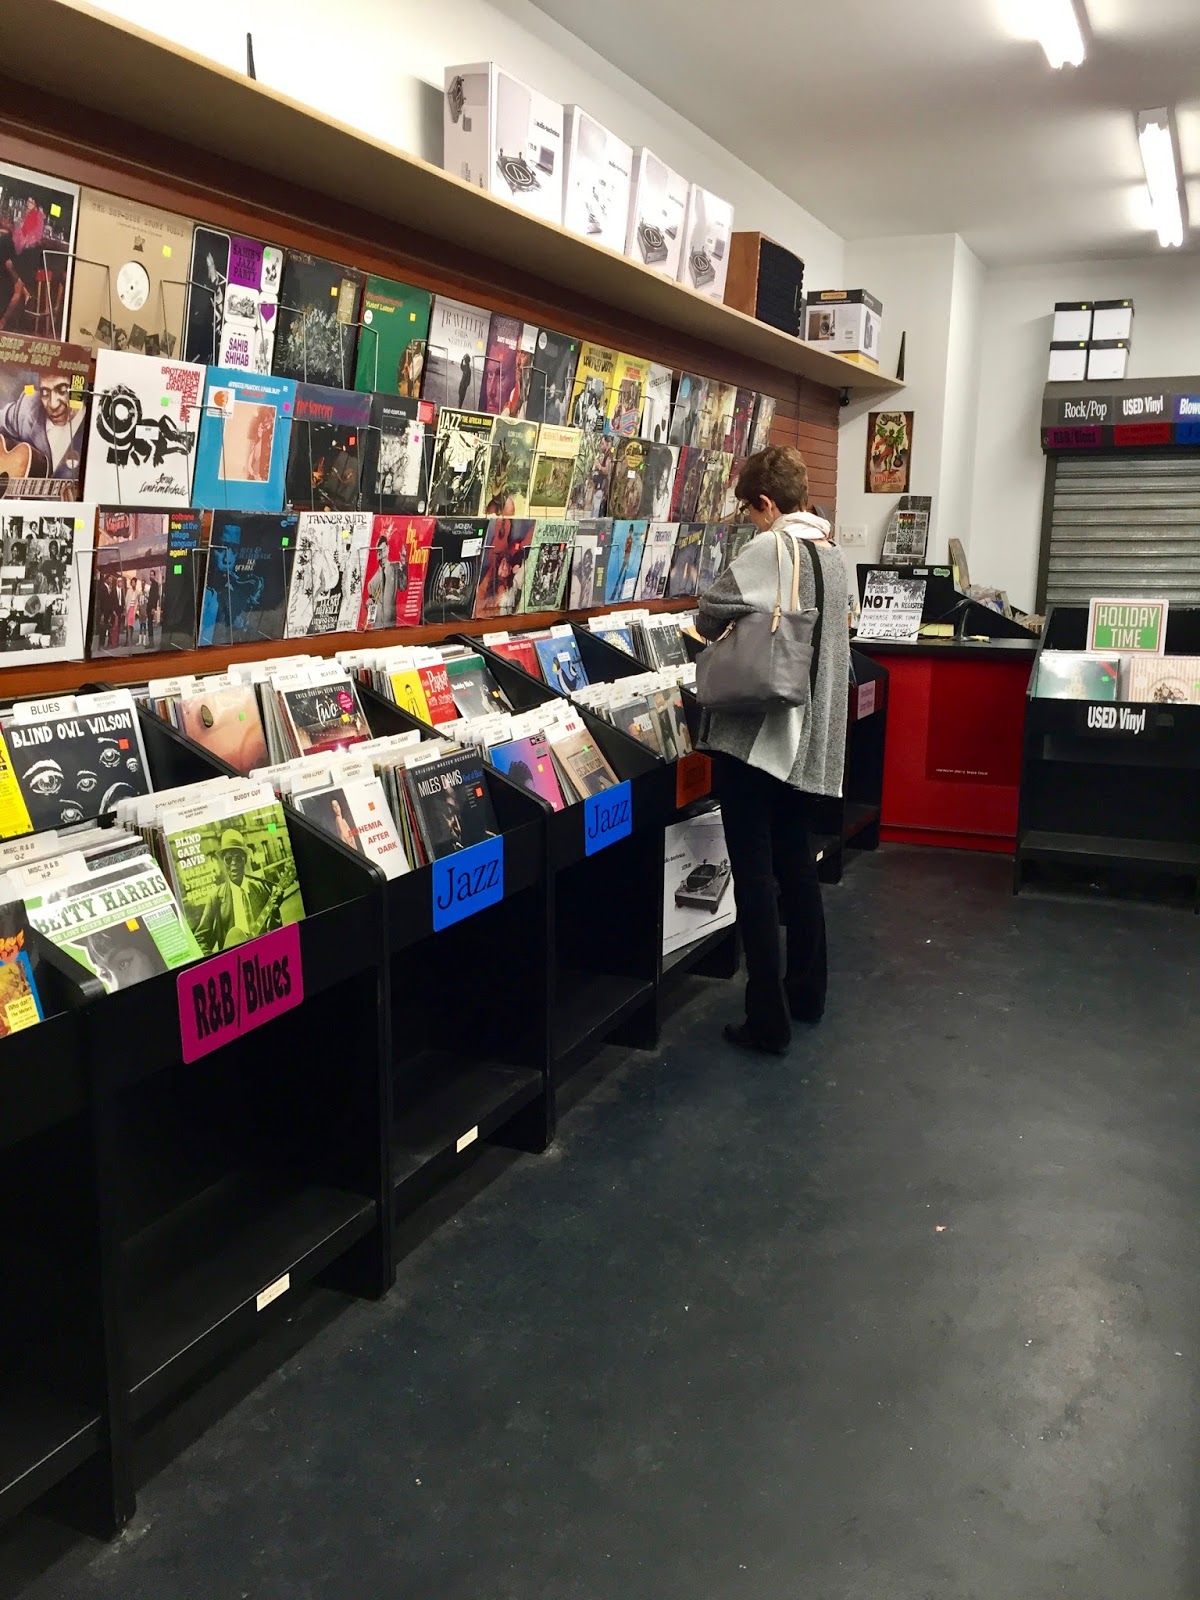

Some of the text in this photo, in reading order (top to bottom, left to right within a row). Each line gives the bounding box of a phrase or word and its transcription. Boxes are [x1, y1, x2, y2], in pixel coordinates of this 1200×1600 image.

[236, 257, 256, 271] JAZZ
[233, 267, 257, 282] PARTY
[228, 338, 249, 353] SAHIB
[224, 351, 250, 367] SHIHAB
[72, 374, 85, 386] 180
[1064, 399, 1108, 421] Rock/Pop
[1122, 395, 1164, 416] USED Vinyl
[1179, 398, 1200, 415] Blow
[440, 411, 461, 430] JAZZ
[171, 512, 195, 521] coltrane
[306, 514, 343, 525] TANNER
[171, 522, 182, 530] live
[188, 522, 199, 531] the
[170, 530, 190, 540] village
[170, 539, 197, 548] vanguard
[169, 548, 188, 558] again!
[867, 585, 902, 595] THIS IS
[863, 595, 894, 609] NOT
[1098, 606, 1158, 628] HOLIDAY
[1111, 628, 1142, 648] TIME
[30, 702, 61, 715] BLUES
[315, 698, 339, 727] two
[1087, 705, 1146, 735] USED Vinyl
[11, 712, 132, 748] BLIND OWL WILSON
[390, 738, 399, 746] BILL
[415, 751, 477, 776] ORIGINAL MASTER RECORDING
[311, 769, 325, 778] ALPERT
[417, 769, 463, 798] MILES DAVIS
[233, 789, 261, 802] BUDDY GUY
[587, 799, 630, 840] Jazz
[348, 819, 383, 837] BOHEMIA
[174, 833, 201, 849] BLIND
[367, 830, 390, 845] AFTER
[3, 847, 18, 855] MISC.
[177, 845, 201, 860] GARY
[377, 841, 398, 855] DARK
[179, 854, 206, 870] DAVIS
[27, 865, 43, 875] MISC.
[41, 871, 51, 879] H-P
[437, 858, 500, 910] Jazz
[33, 874, 167, 935] BETTY HARRIS
[63, 928, 79, 939] LOST
[81, 921, 102, 936] QUEEN
[112, 911, 126, 921] NEW
[127, 902, 153, 916] ORLEANS
[192, 953, 292, 1041] R&B/Blues
[8, 1002, 20, 1011] Who
[19, 1006, 33, 1014] Meters
